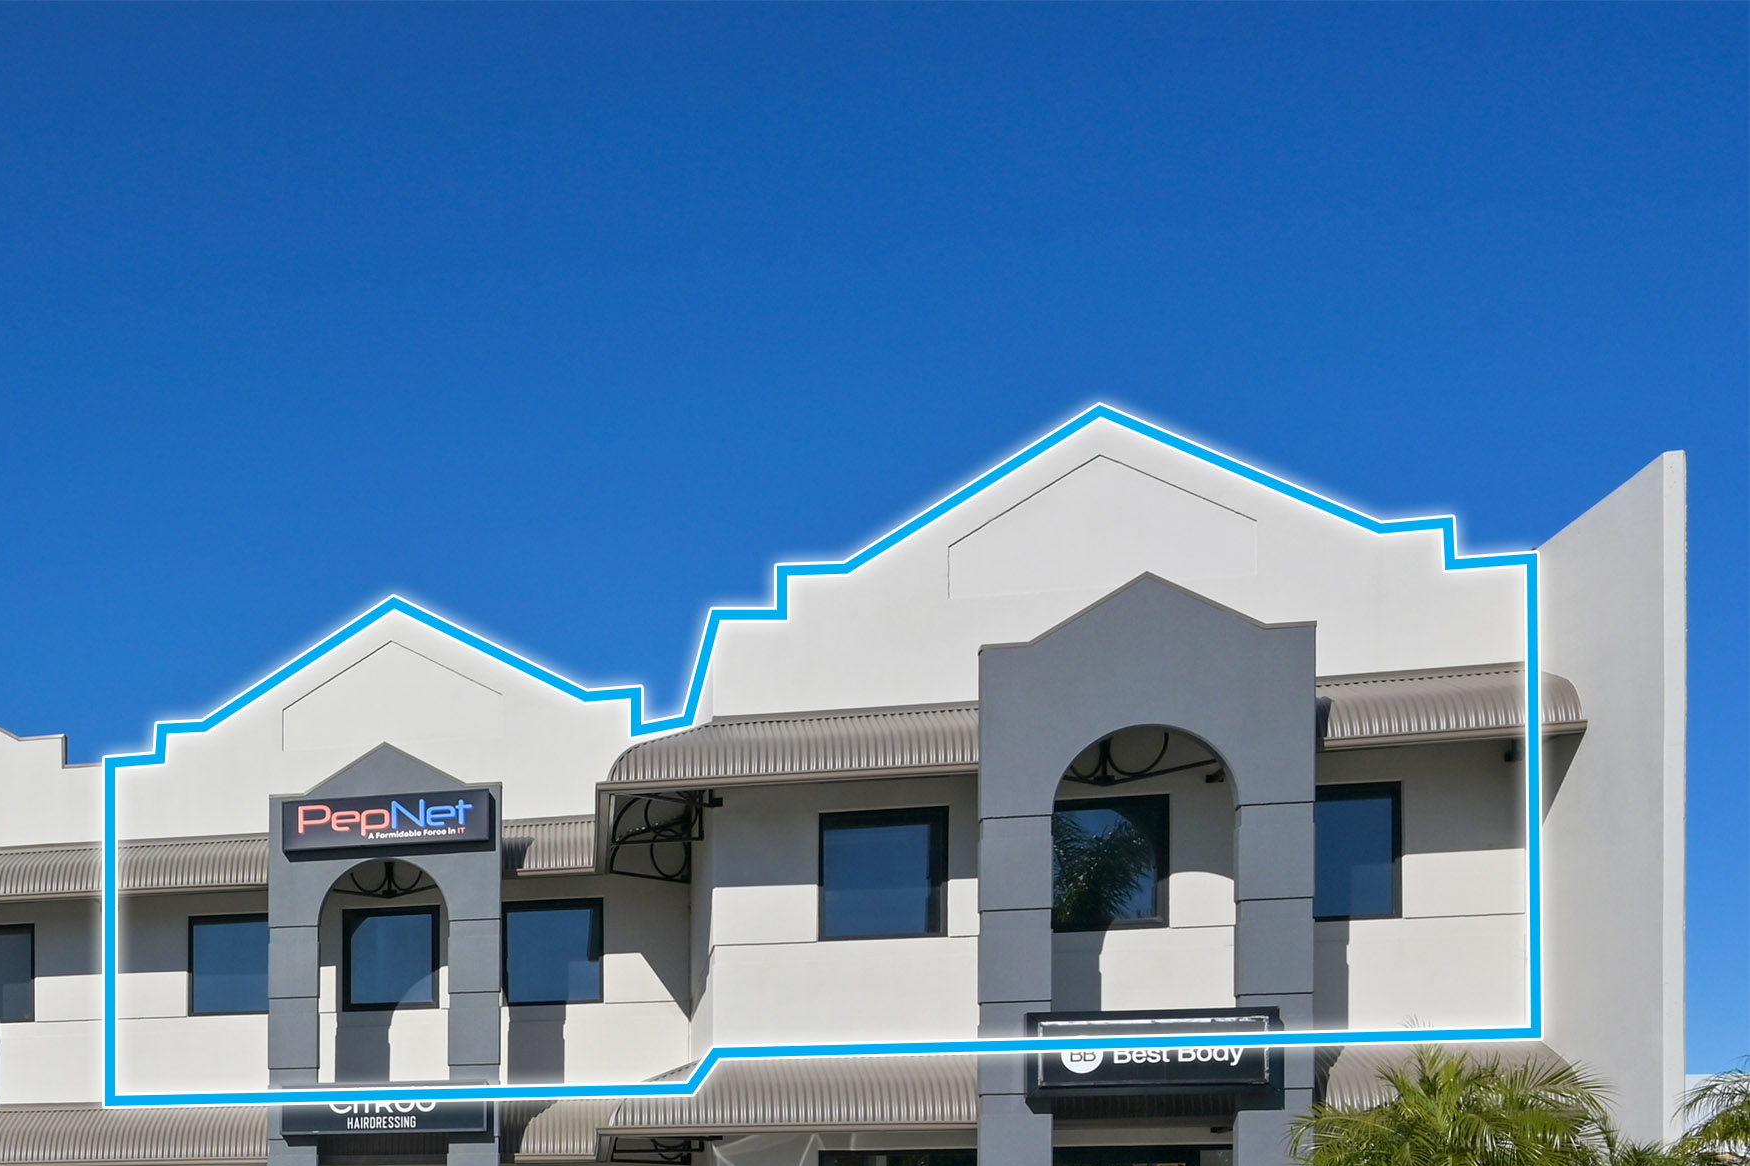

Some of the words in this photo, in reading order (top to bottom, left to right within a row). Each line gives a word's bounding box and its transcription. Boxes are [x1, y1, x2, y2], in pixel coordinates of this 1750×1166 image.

[297, 798, 474, 836] PepNet
[375, 830, 422, 839] Formidable
[1113, 1050, 1170, 1064] Best
[1177, 1047, 1244, 1066] Body
[347, 1116, 417, 1129] HAIRDRESSING
